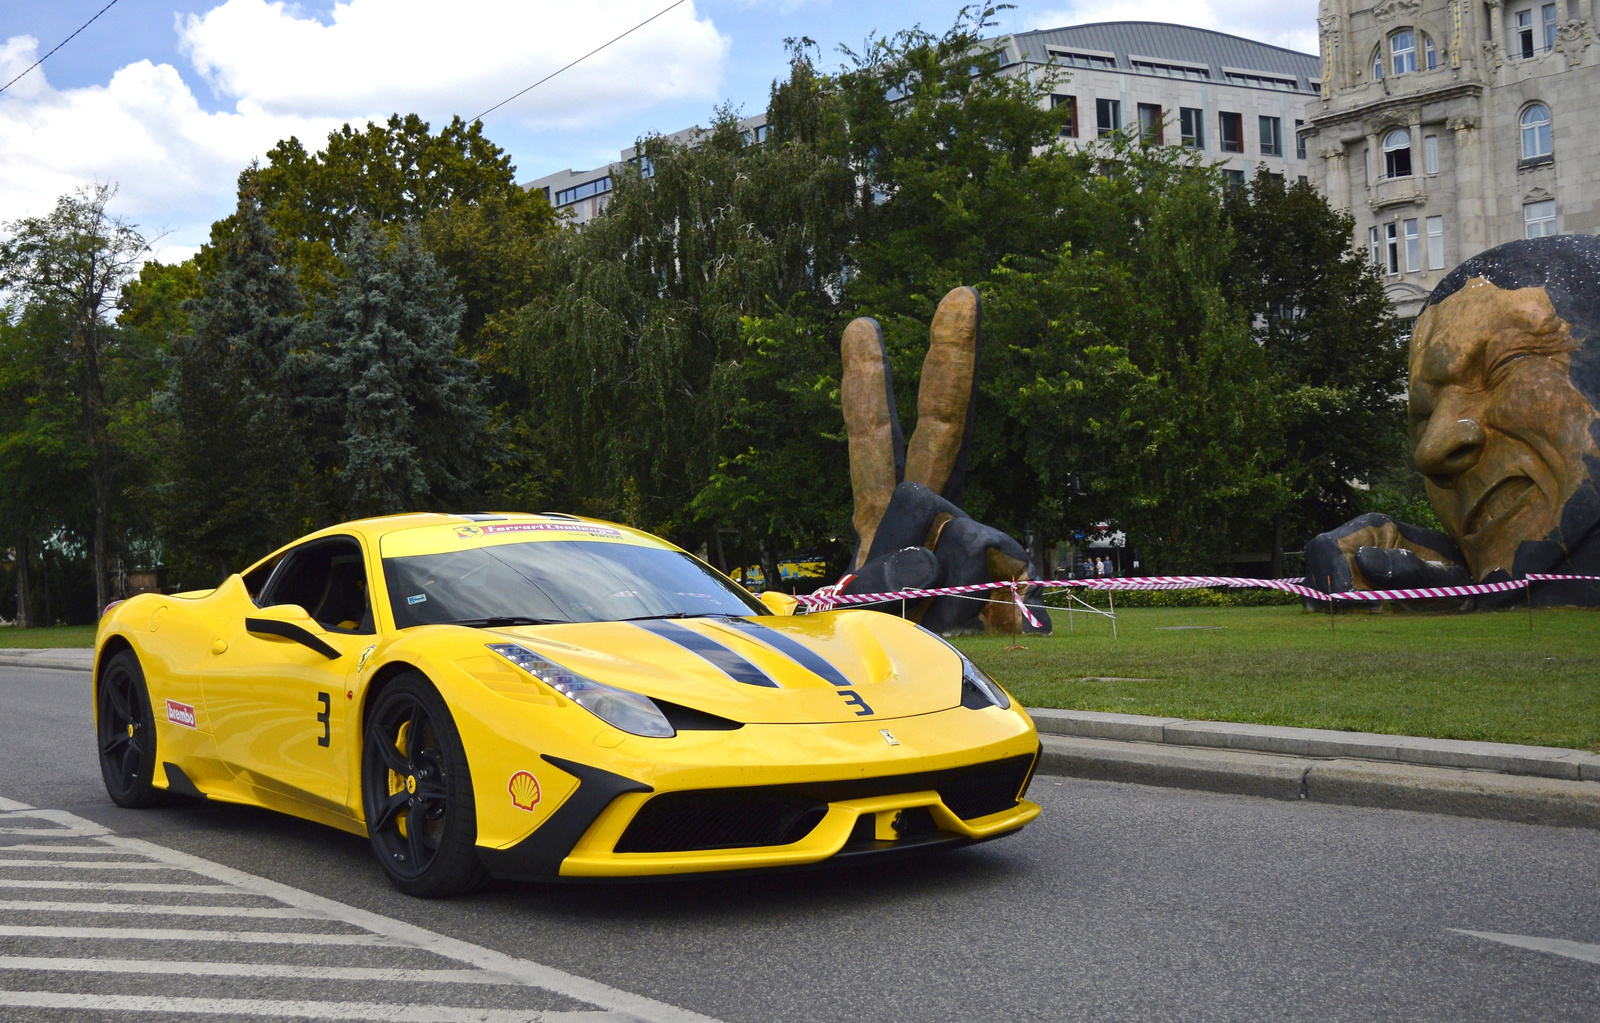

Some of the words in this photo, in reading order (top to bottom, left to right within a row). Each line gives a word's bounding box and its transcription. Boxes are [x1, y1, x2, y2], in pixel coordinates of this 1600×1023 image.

[487, 524, 545, 533] Ferrari
[546, 524, 614, 534] Challenge
[168, 703, 194, 725] brembo
[836, 690, 875, 716] 3
[317, 691, 331, 748] 3
